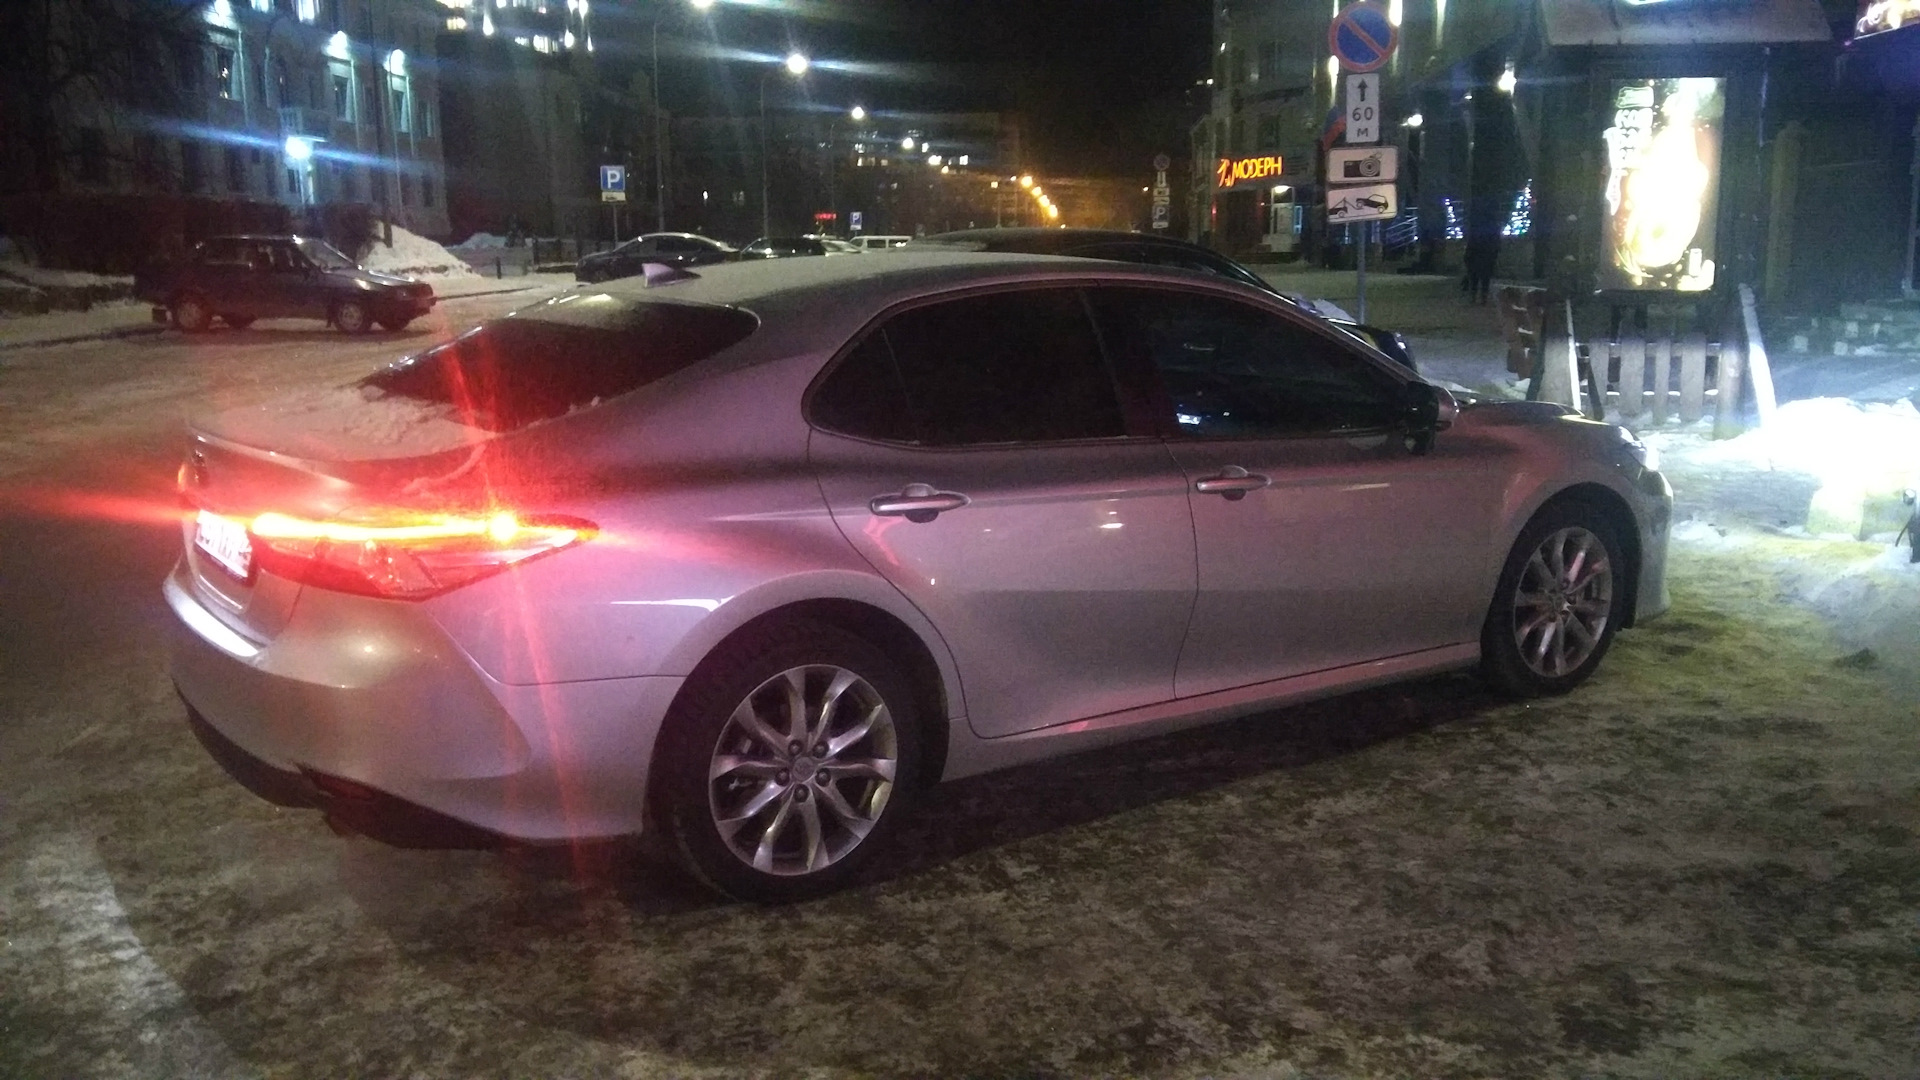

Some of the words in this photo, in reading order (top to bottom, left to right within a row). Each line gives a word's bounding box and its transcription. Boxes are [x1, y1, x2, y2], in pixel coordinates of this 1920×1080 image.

[1352, 106, 1373, 122] 60
[1231, 156, 1283, 186] МОДЕРН
[607, 170, 621, 189] P
[852, 212, 860, 224] P
[1155, 206, 1166, 219] P
